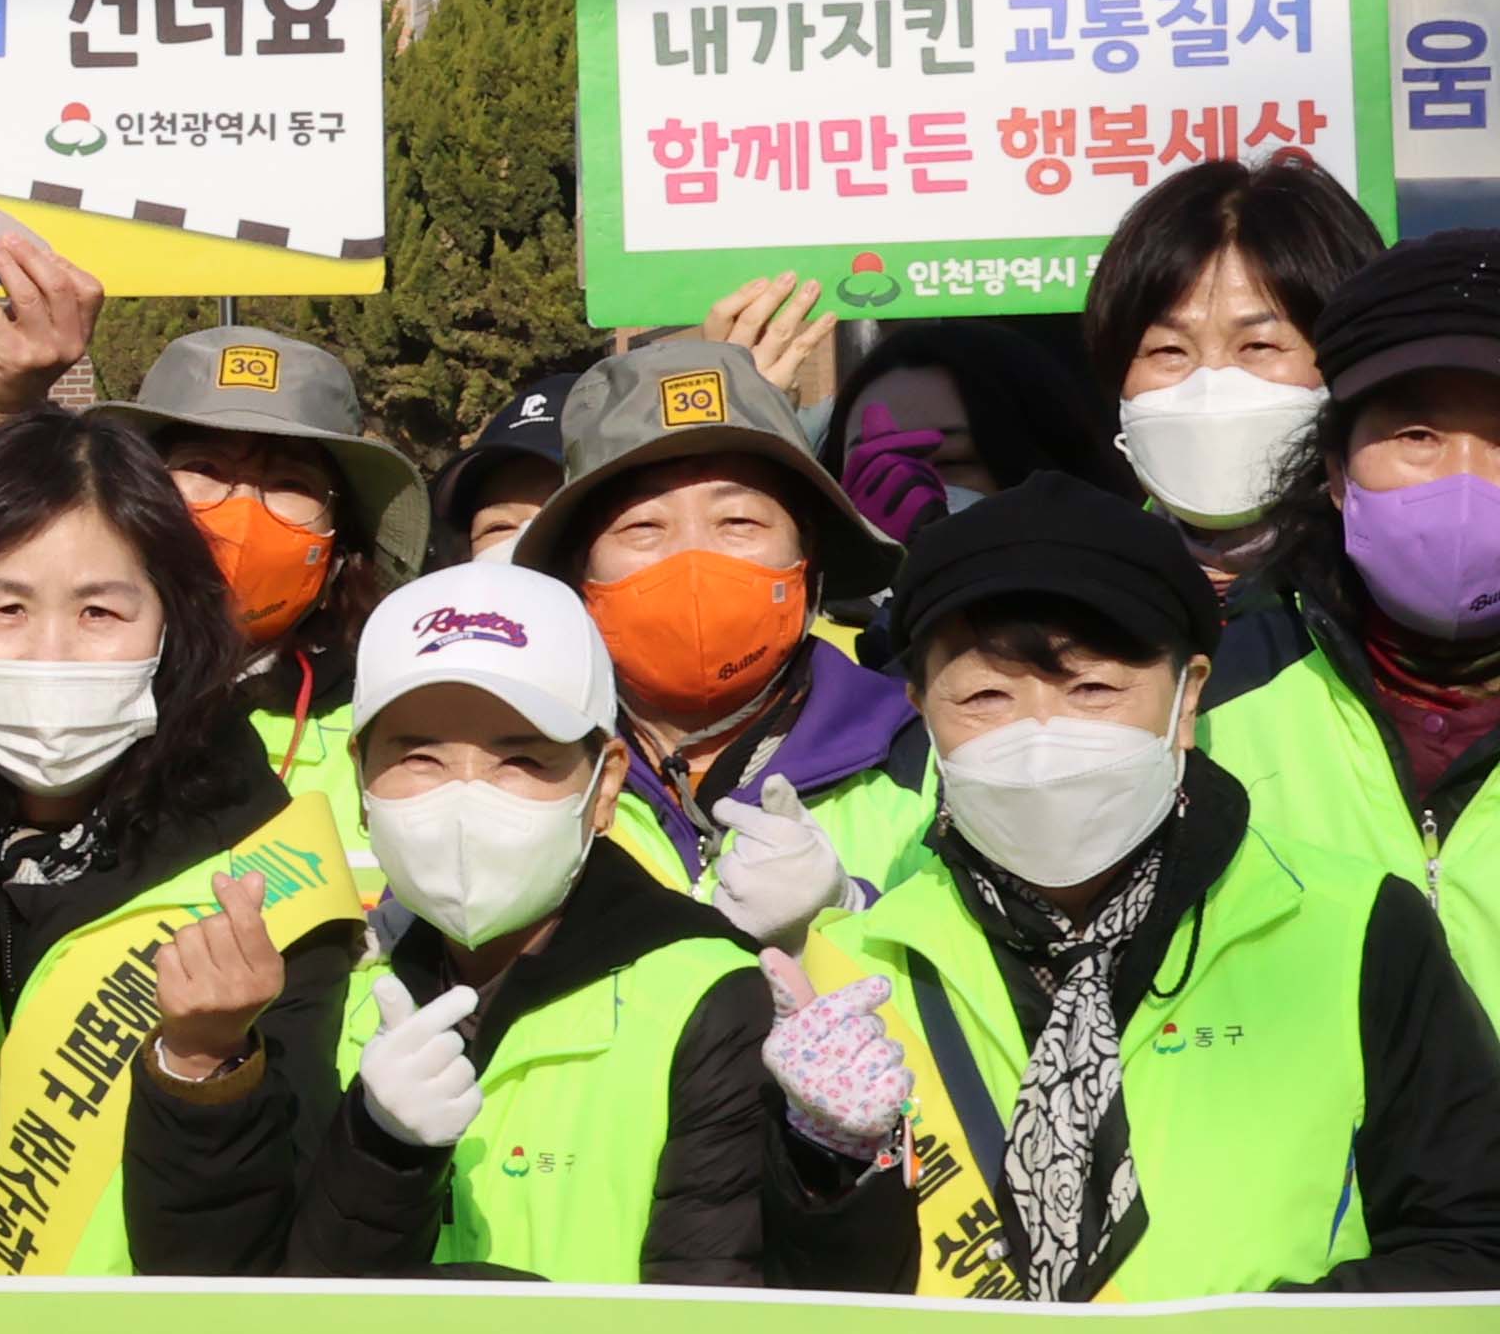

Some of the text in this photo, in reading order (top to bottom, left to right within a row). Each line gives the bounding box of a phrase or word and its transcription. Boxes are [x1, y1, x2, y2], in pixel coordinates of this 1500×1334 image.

[115, 109, 346, 148] 인천광역시 동구
[647, 110, 975, 205] 함께만든
[907, 257, 1076, 296] 인천광역시
[673, 389, 713, 413] 30
[1194, 1024, 1245, 1048] 동구
